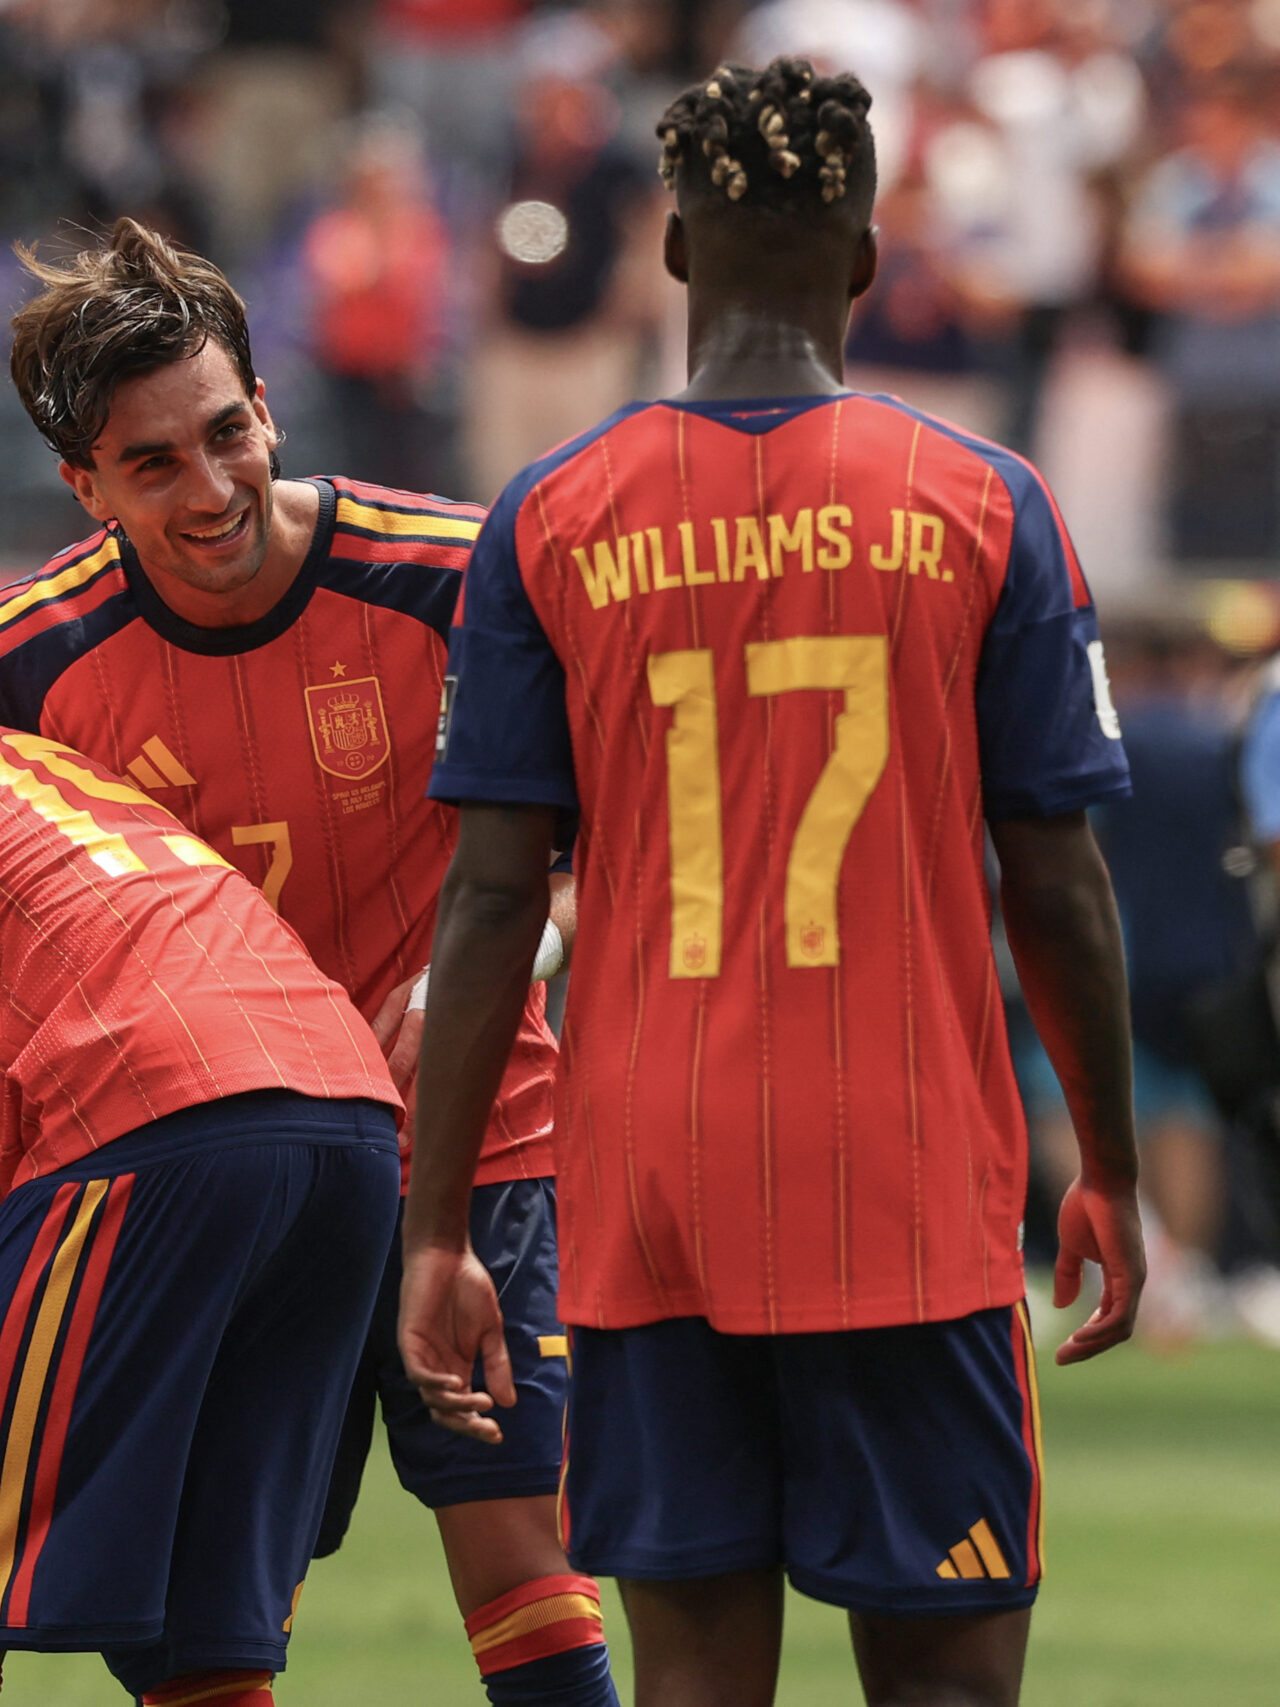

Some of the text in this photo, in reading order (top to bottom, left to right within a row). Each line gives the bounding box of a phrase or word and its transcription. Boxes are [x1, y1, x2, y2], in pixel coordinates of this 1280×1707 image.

[572, 504, 954, 610] WILLIAMS JR.
[647, 635, 889, 979] 17
[231, 821, 293, 912] 7
